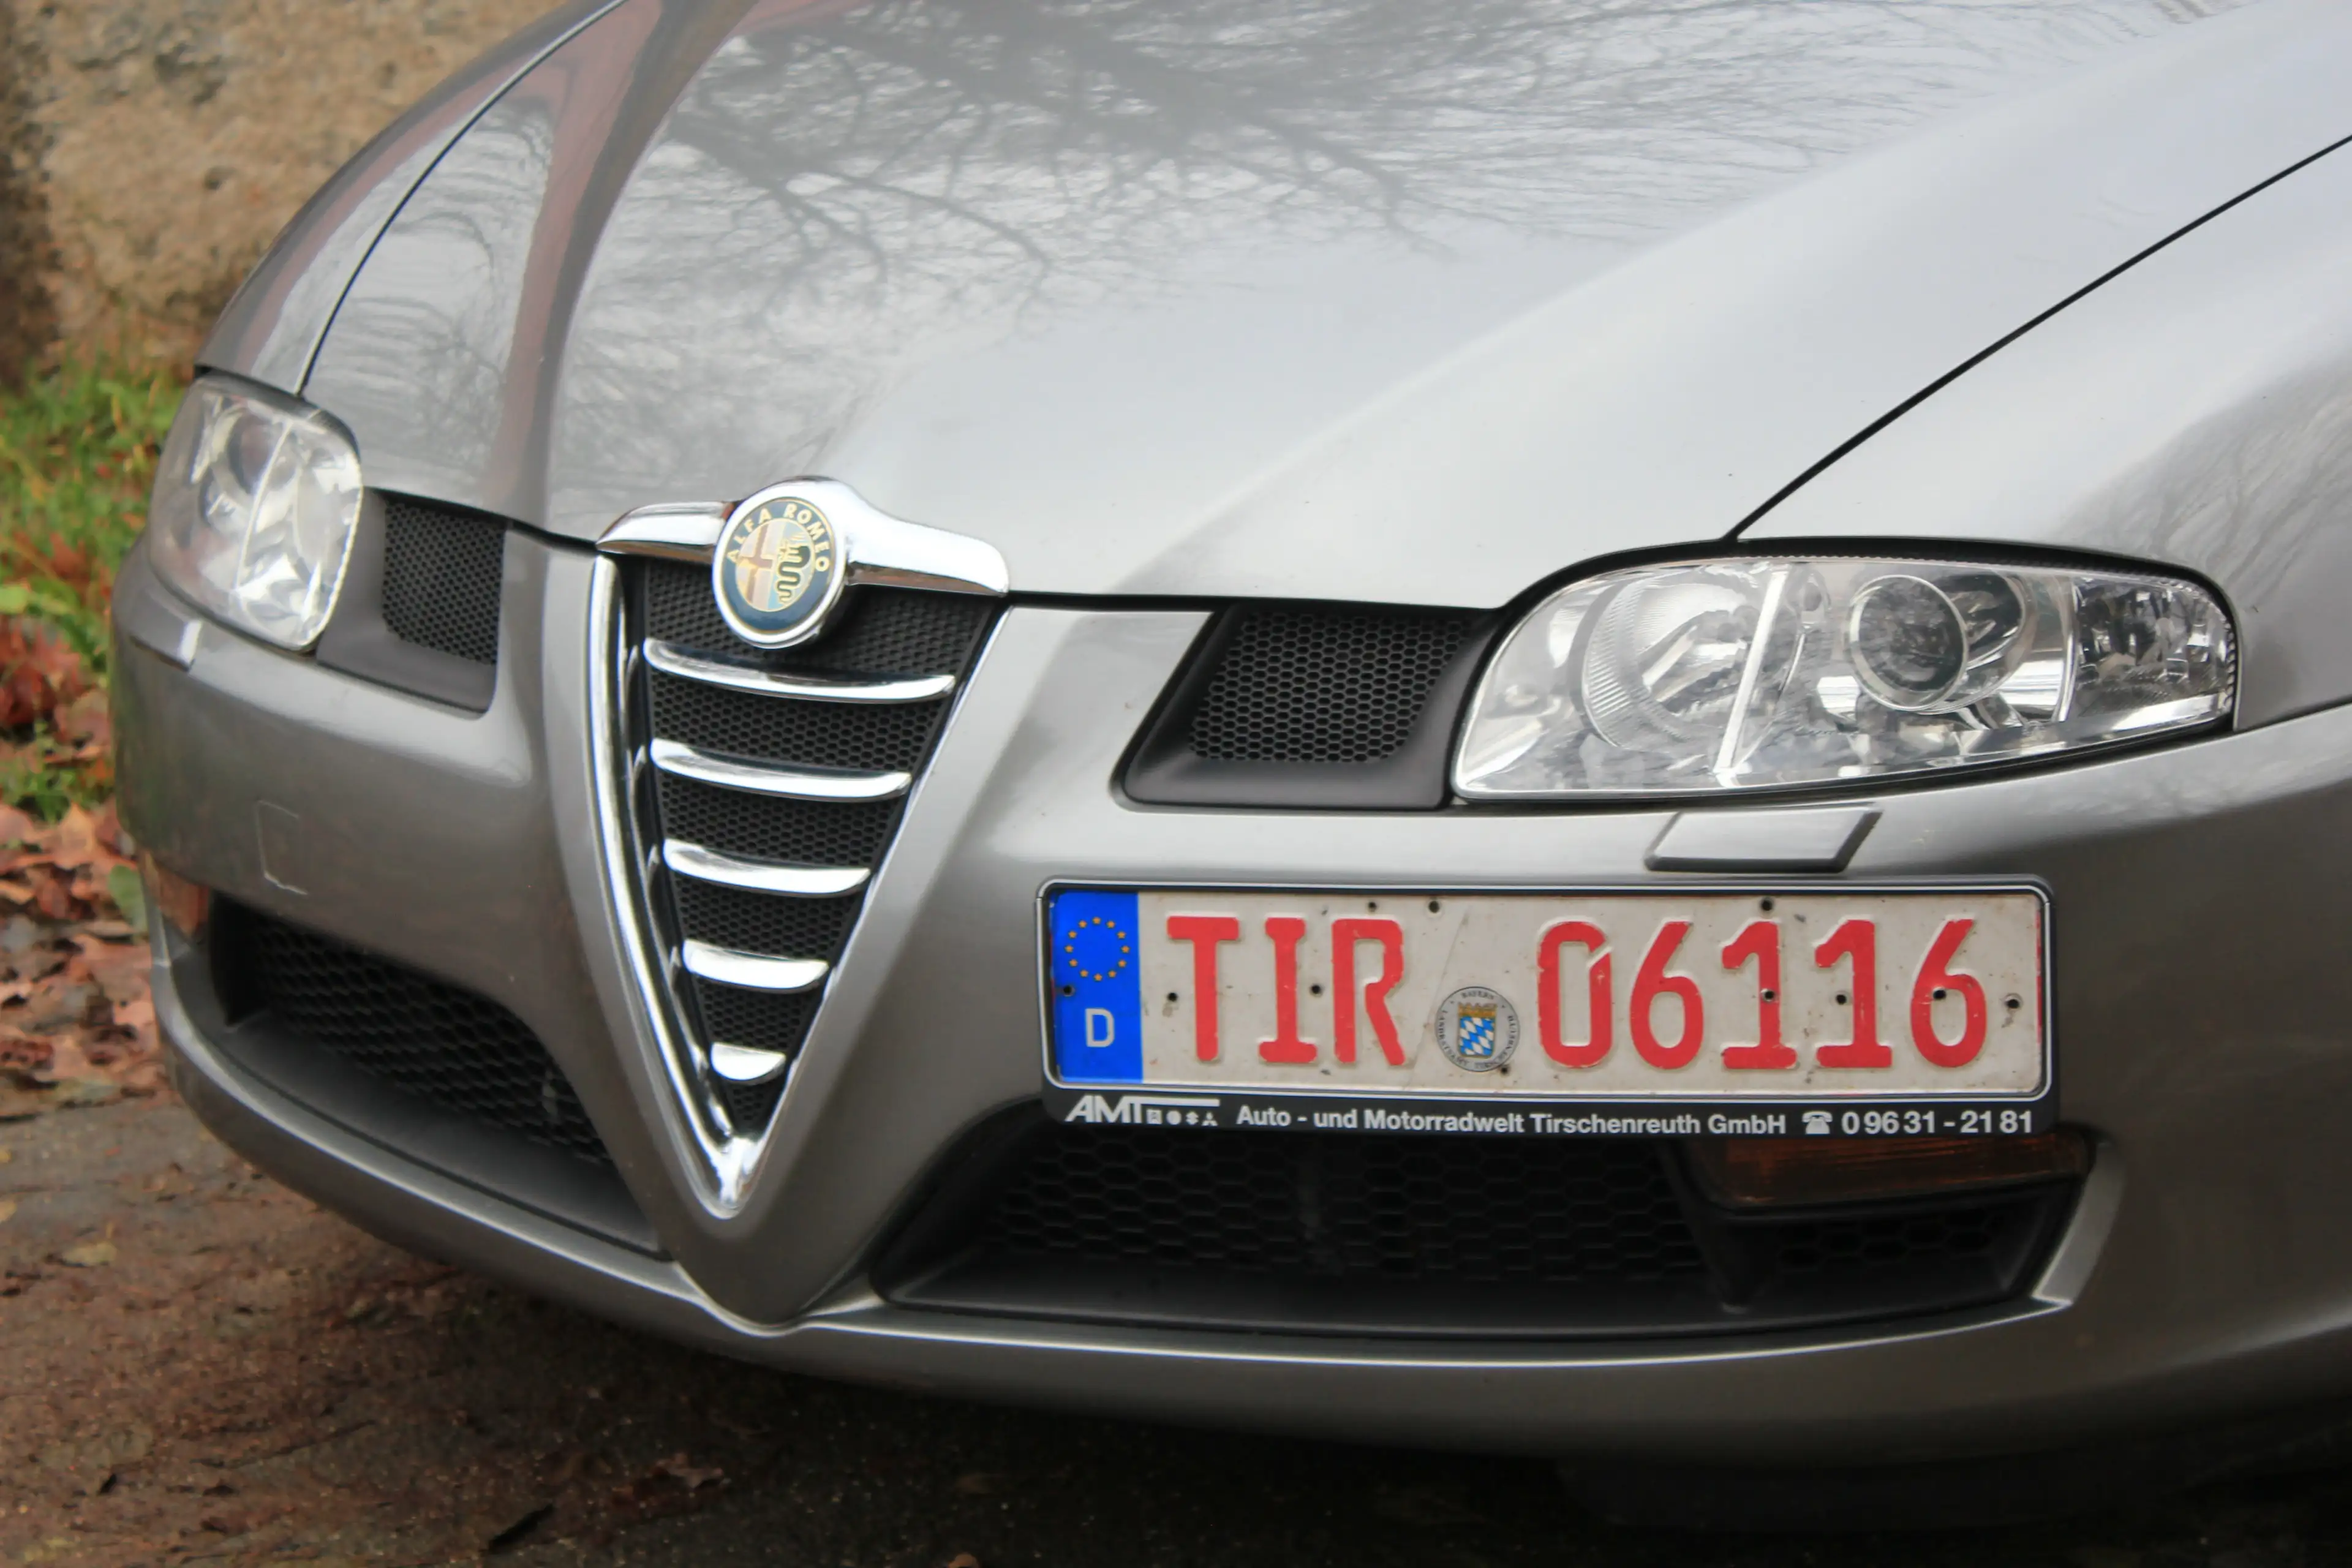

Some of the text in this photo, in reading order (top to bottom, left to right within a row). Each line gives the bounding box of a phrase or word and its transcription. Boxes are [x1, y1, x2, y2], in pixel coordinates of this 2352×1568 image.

[727, 503, 829, 571] ALFA ROMEO
[1166, 916, 1988, 1069] TIR 06116
[1085, 1008, 1115, 1047] D
[1065, 1095, 1220, 1125] AMT
[1313, 1109, 1357, 1129] und
[1364, 1109, 1524, 1133] Motorradwelt
[1529, 1114, 1700, 1134] Tirschenreuth
[1708, 1114, 1786, 1134] GmbH
